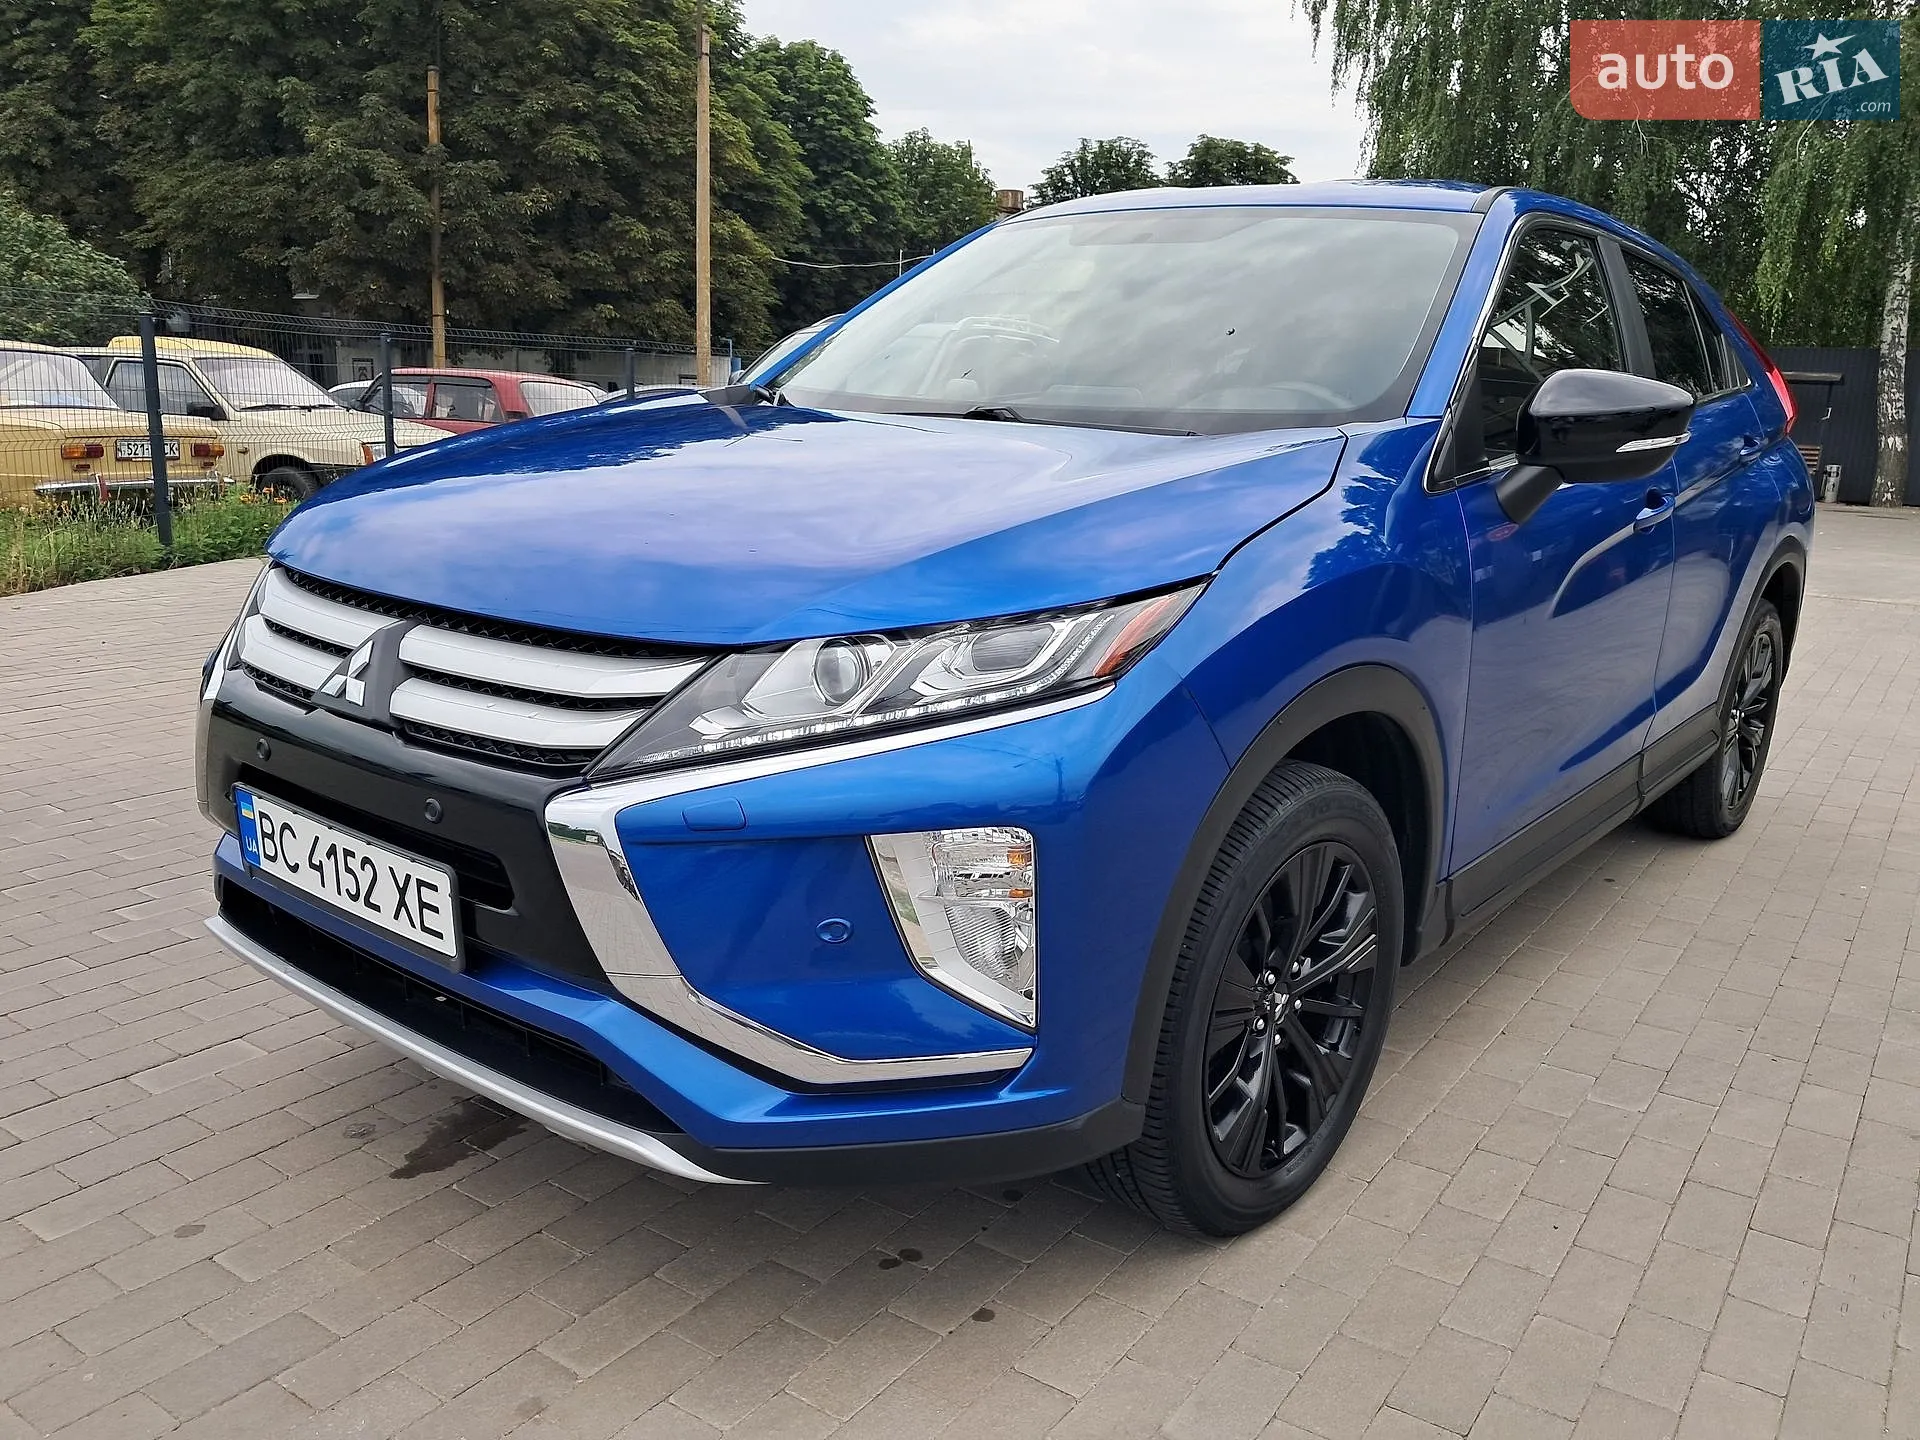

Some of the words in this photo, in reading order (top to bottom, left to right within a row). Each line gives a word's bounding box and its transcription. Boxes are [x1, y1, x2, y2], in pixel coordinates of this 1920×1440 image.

[246, 838, 258, 855] UA
[259, 811, 299, 873] BC
[308, 836, 381, 913] 4152
[388, 865, 444, 940] XE
